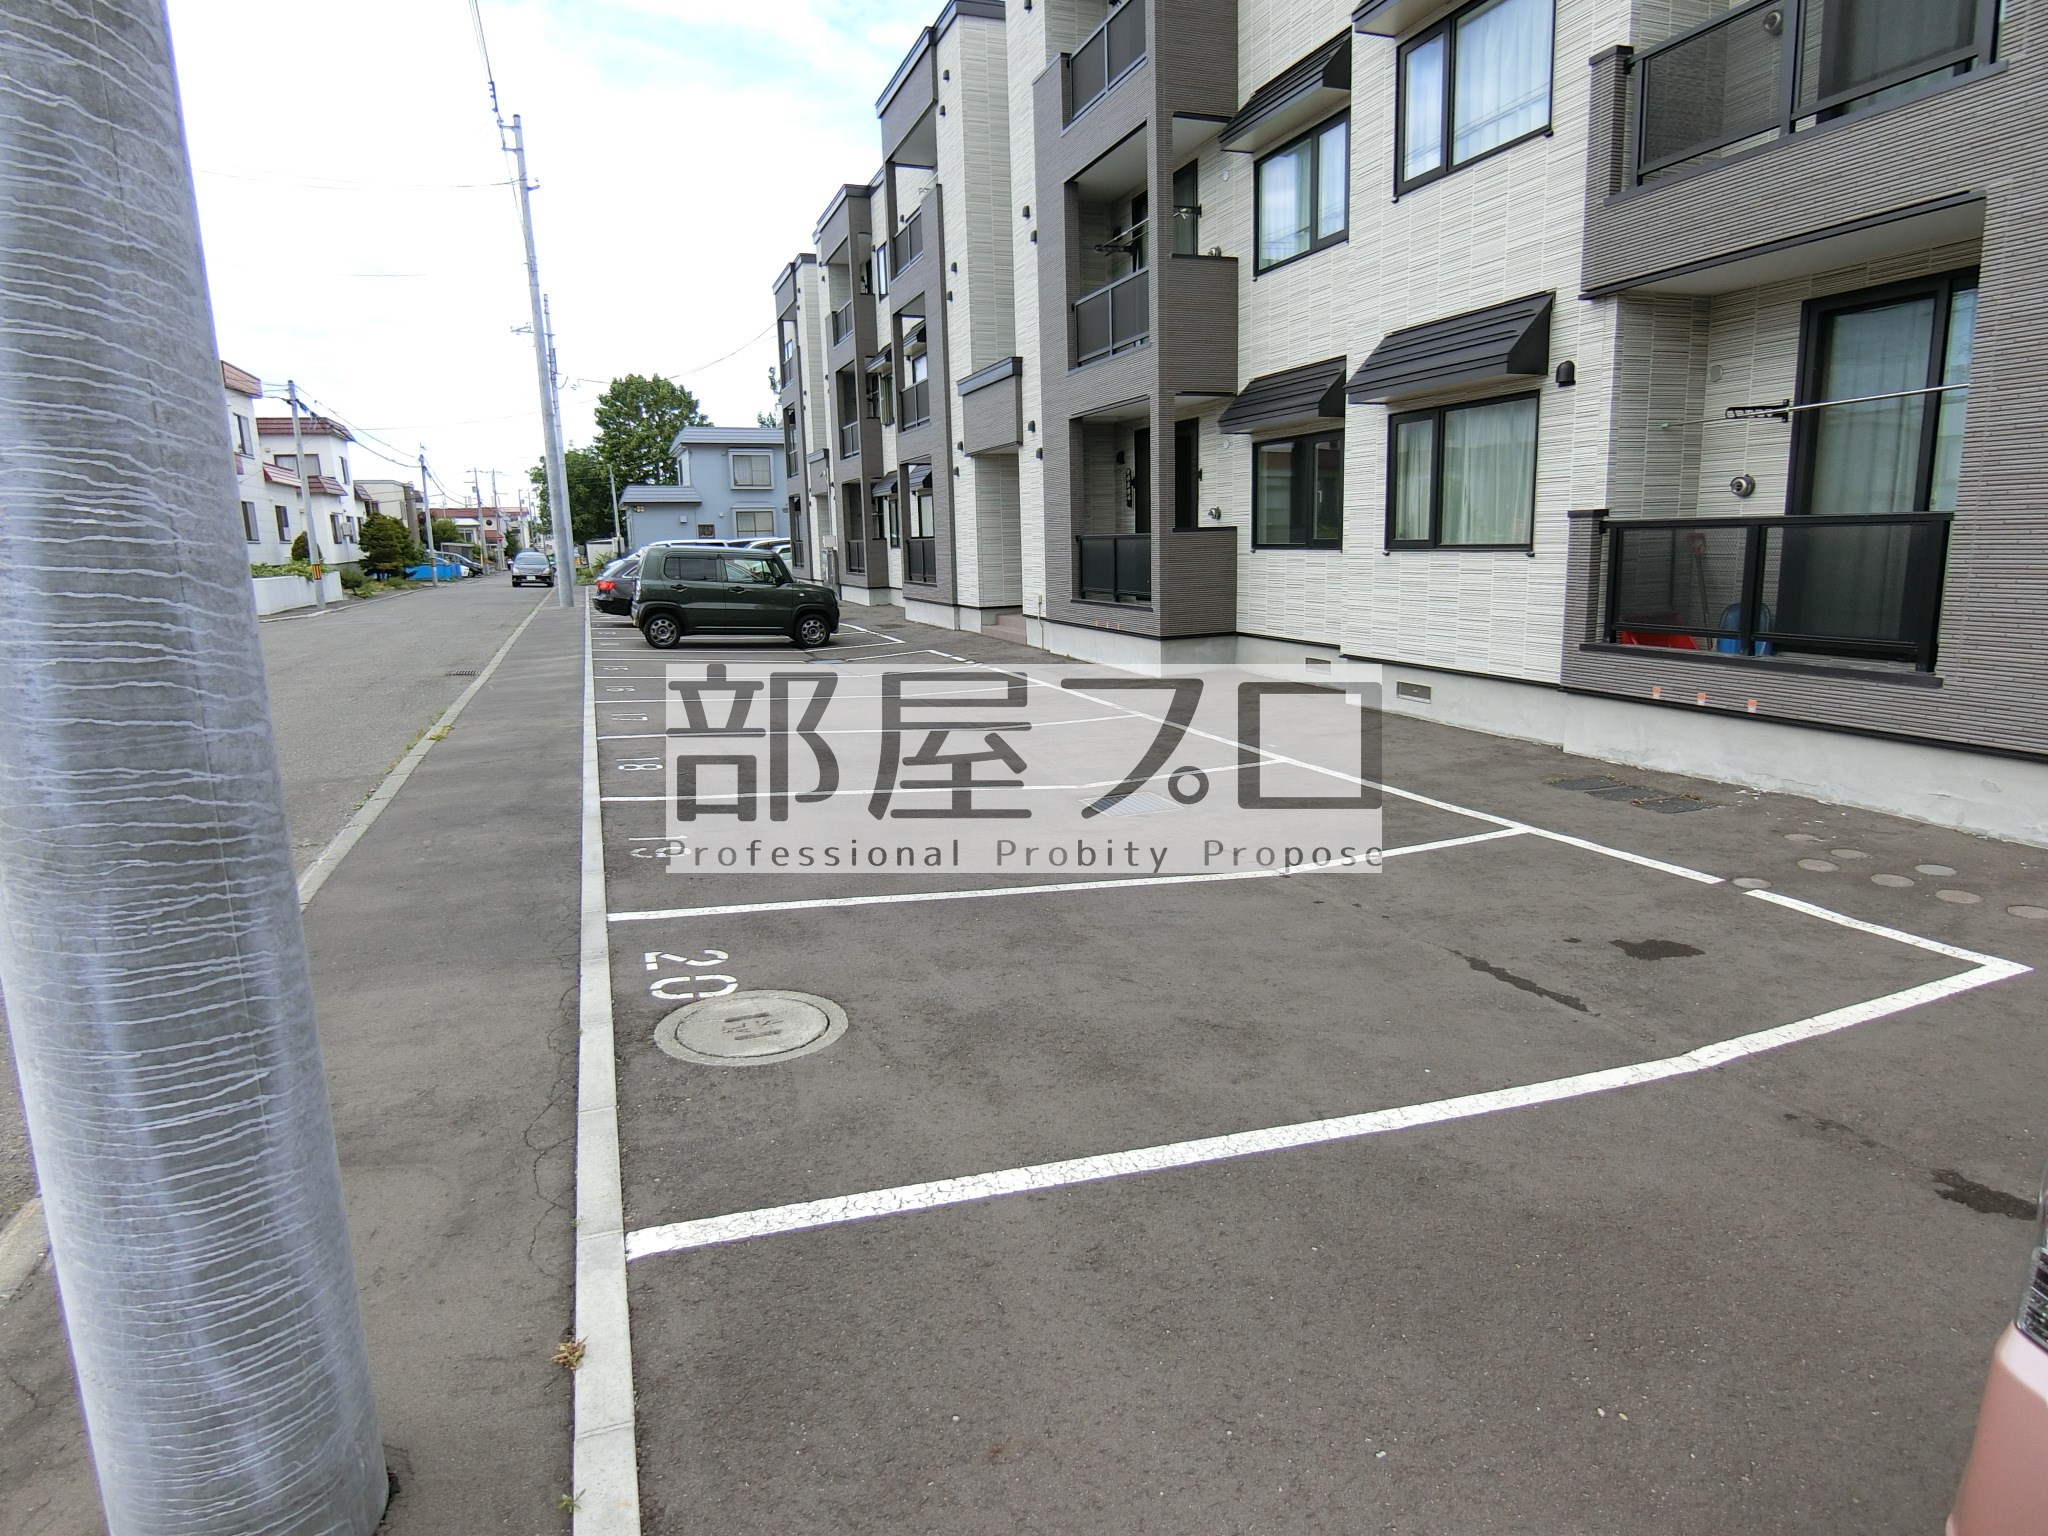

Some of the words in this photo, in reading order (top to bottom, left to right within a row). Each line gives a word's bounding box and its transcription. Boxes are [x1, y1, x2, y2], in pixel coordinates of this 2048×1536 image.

[616, 756, 663, 771] 18
[628, 834, 692, 859] 19
[644, 949, 739, 1000] 20
